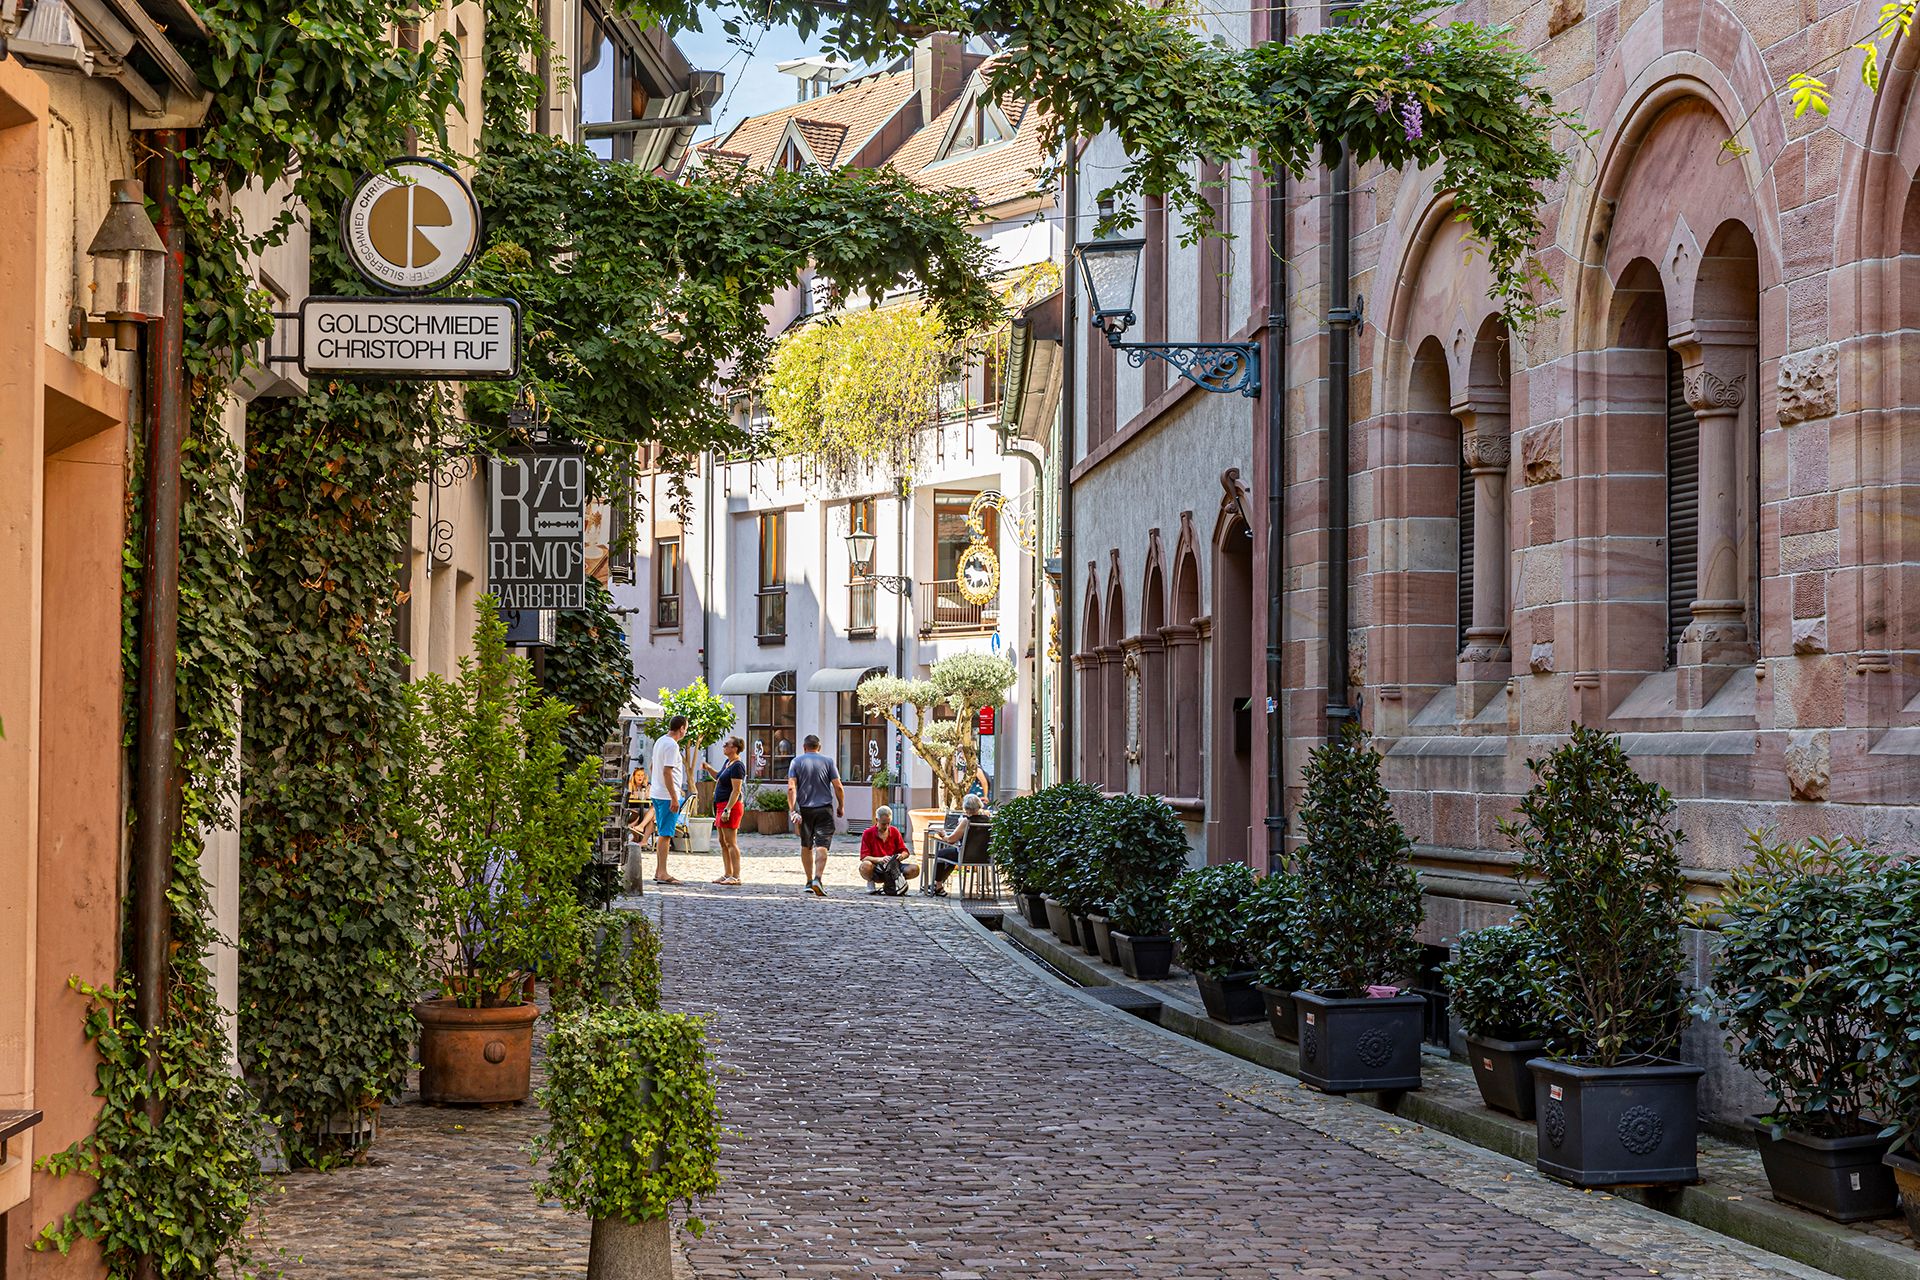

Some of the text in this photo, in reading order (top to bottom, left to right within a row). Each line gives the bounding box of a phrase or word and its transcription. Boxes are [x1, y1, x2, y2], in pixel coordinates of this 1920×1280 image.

[355, 212, 404, 281] SILBERSCHMIED
[318, 313, 499, 335] GOLDSCHMIEDE
[318, 338, 499, 360] CHRISTOPH RUF
[489, 583, 583, 608] BARBEREI
